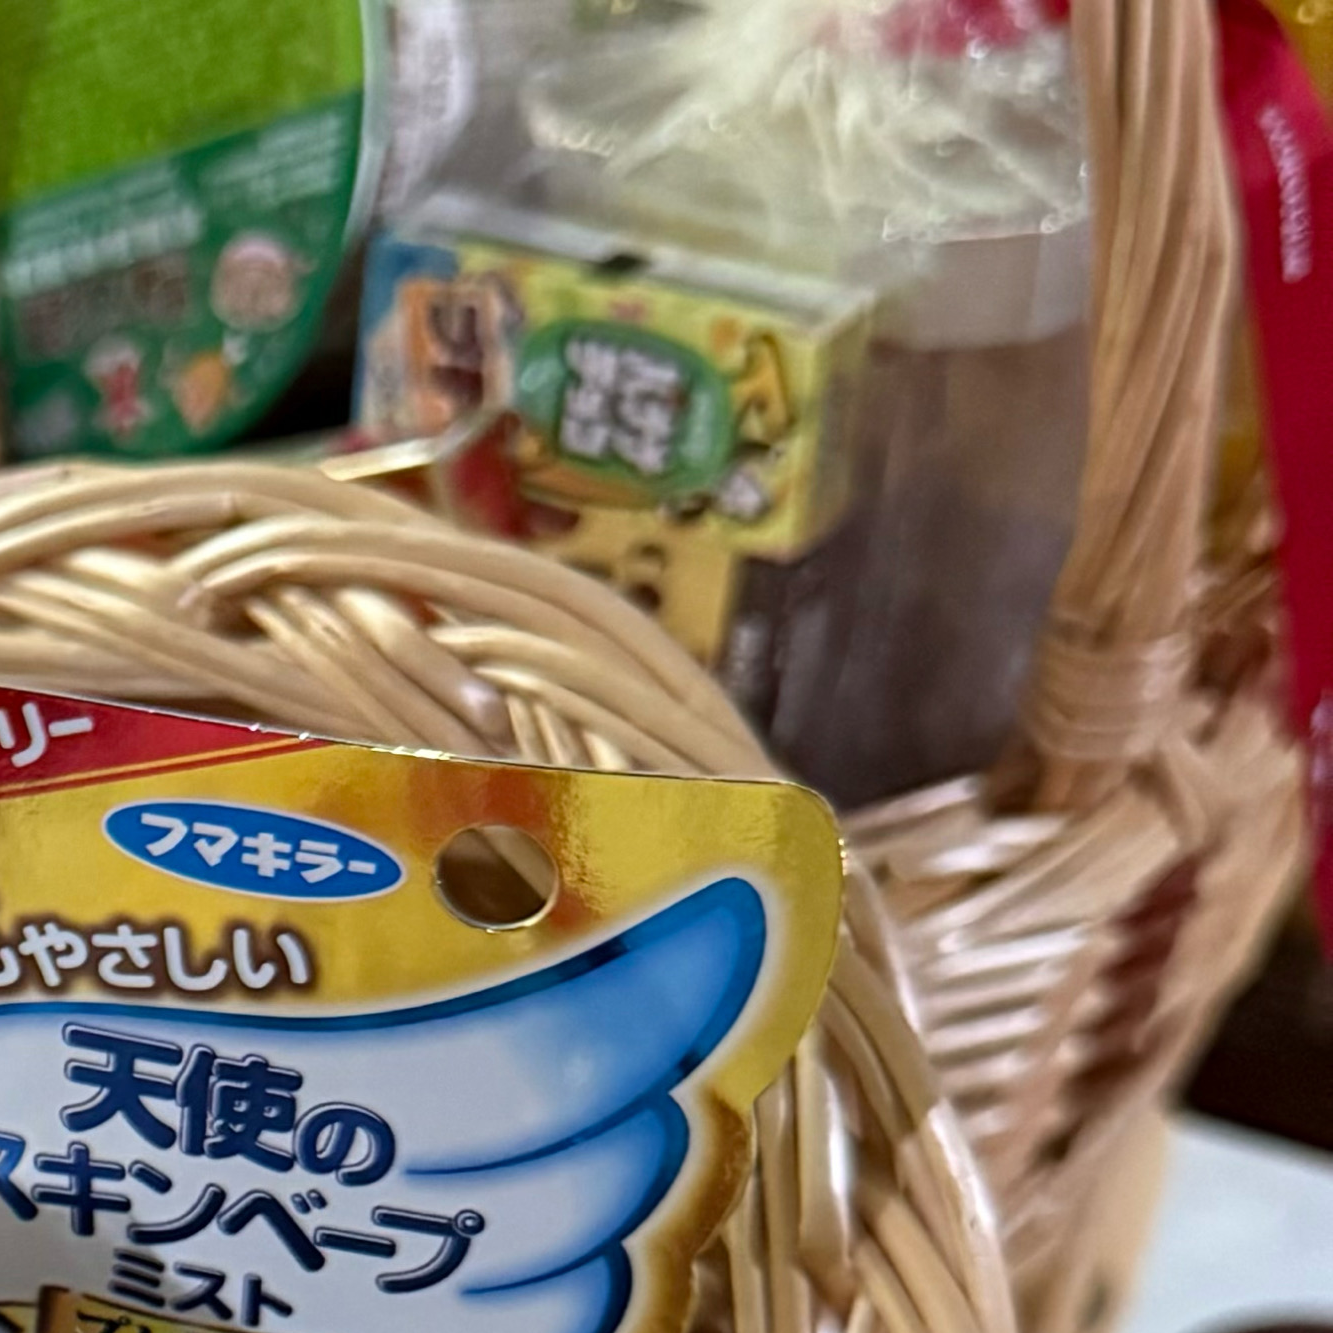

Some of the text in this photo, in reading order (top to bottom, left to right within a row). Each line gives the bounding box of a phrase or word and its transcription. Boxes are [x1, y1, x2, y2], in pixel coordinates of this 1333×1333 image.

[141, 812, 376, 884] フマキラー
[60, 1022, 395, 1187] 天使の
[109, 1248, 293, 1326] ミスト
